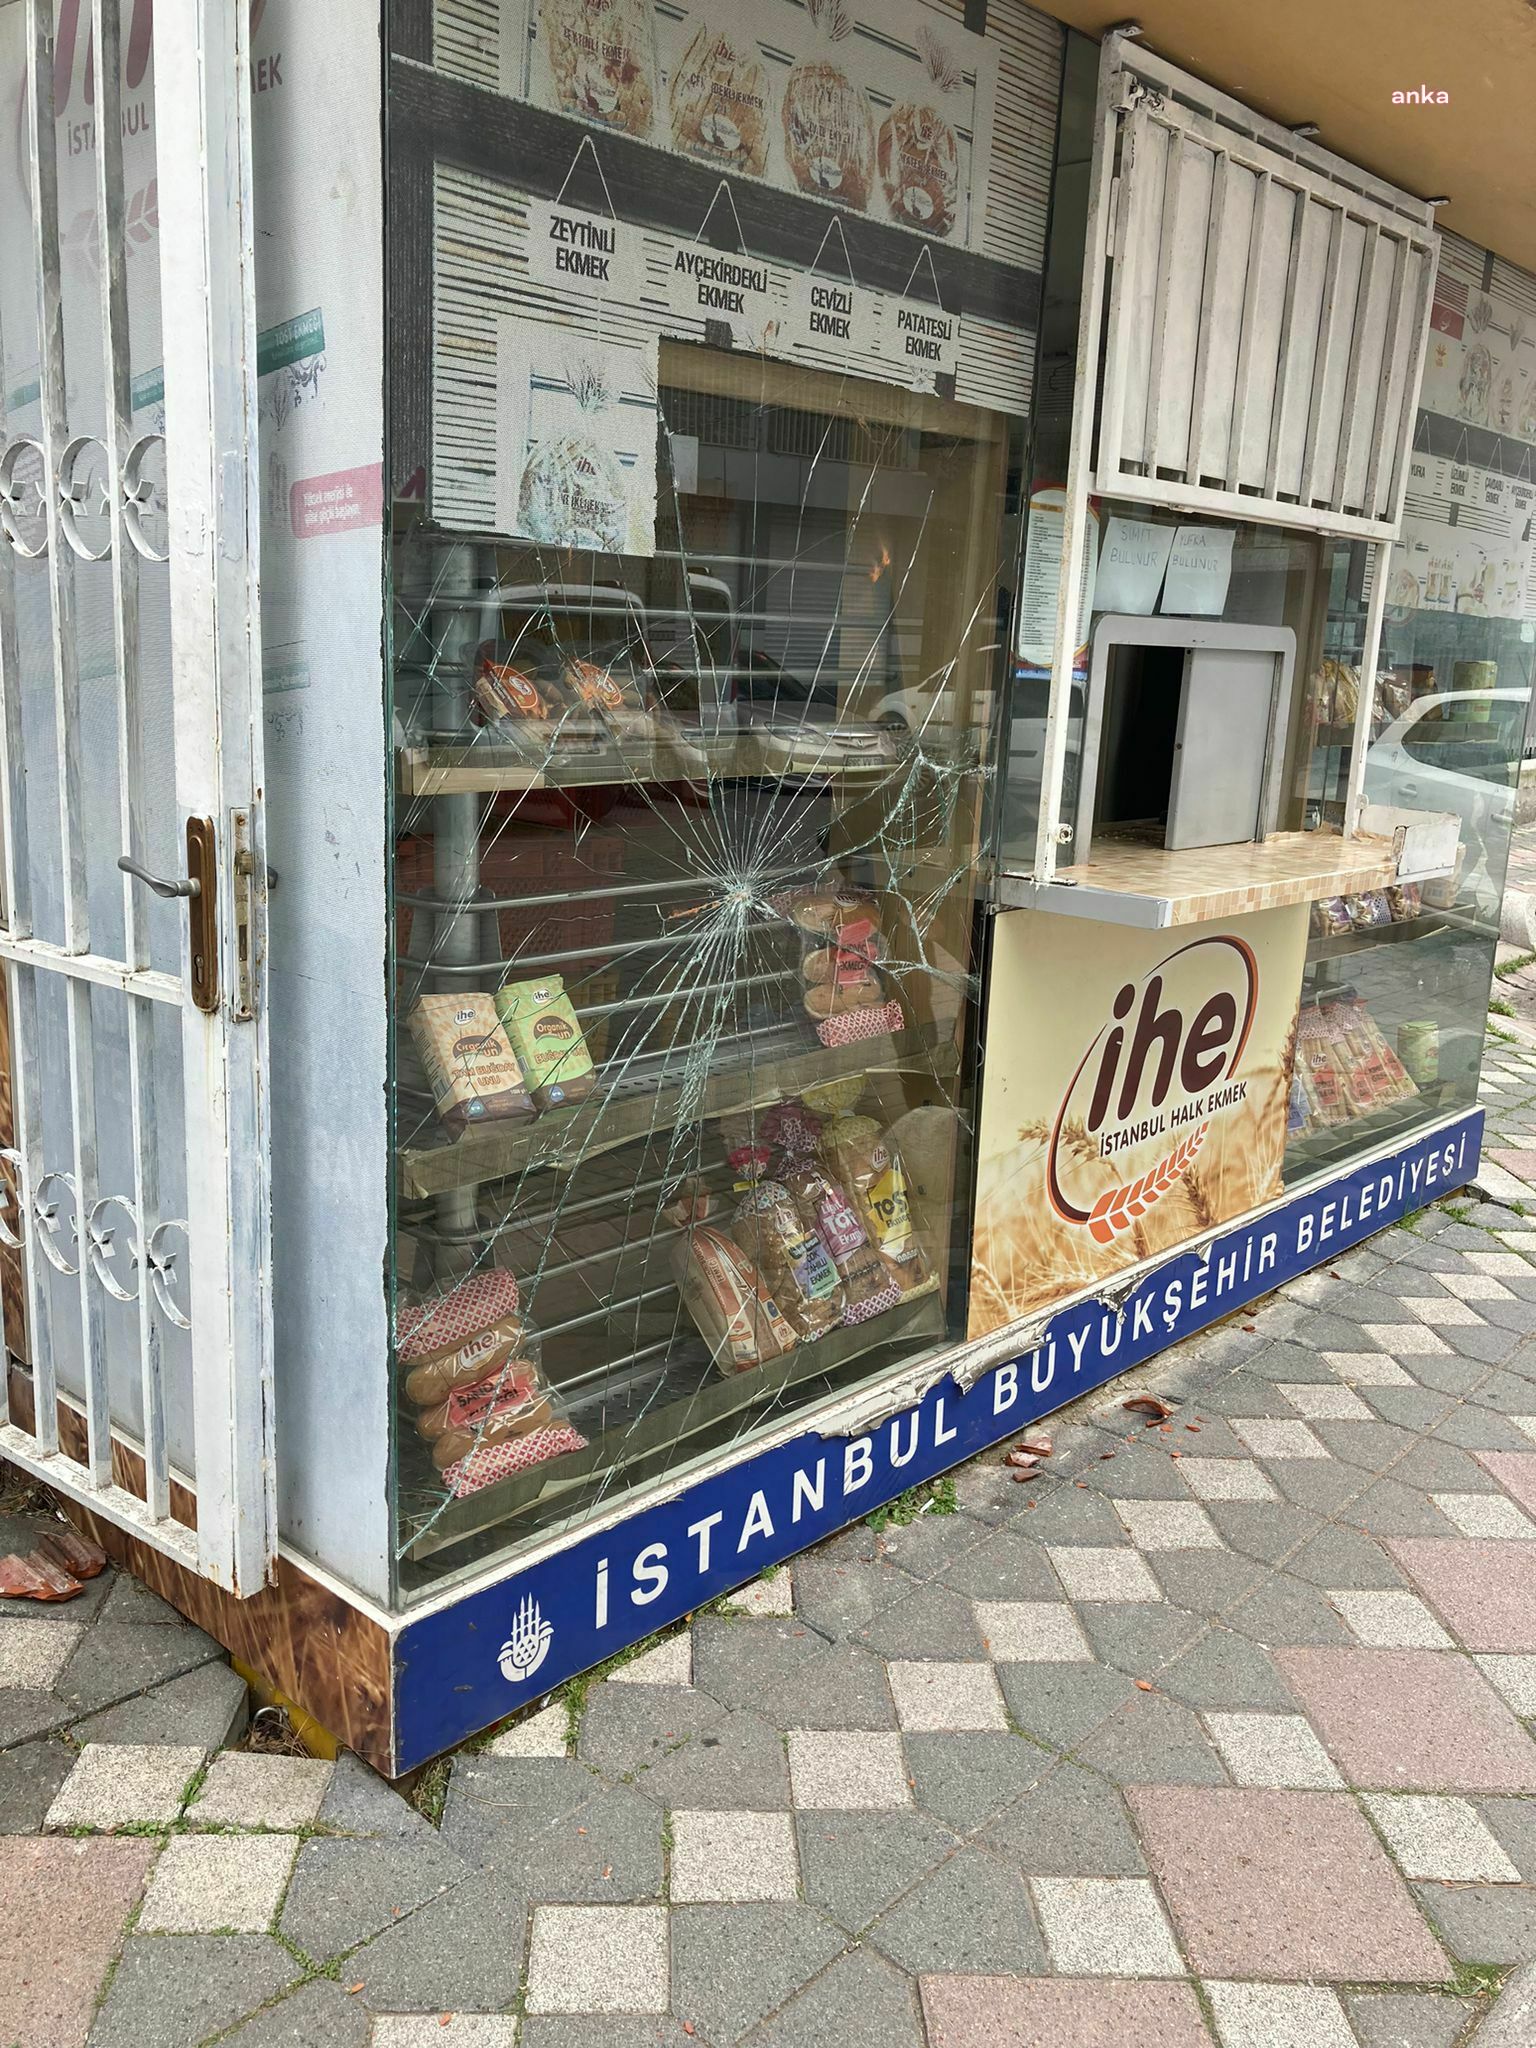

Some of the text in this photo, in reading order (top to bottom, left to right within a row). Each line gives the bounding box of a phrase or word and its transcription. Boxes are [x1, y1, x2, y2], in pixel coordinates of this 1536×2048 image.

[550, 215, 616, 254] ZEYTİNLİ
[556, 247, 610, 281] EKMEK
[674, 250, 768, 293] AYÇEKİRDEKLİ
[698, 284, 745, 314] EKMEK
[811, 286, 853, 315] CEVİZLİ
[809, 311, 851, 340] EKMEK
[897, 309, 952, 341] PATATESLİ
[905, 336, 942, 361] EKMEK
[534, 990, 551, 1000] ihe
[456, 1010, 475, 1021] ihe
[536, 1021, 569, 1034] Organik
[482, 1046, 499, 1057] un
[1088, 975, 1237, 1133] ihe
[476, 1075, 501, 1087] UNU
[1100, 1081, 1248, 1158] İSTANBUL HALK EKMEK
[1297, 1131, 1467, 1254] BELEDİYESİ
[463, 1331, 496, 1359] ihe
[595, 1397, 957, 1630] İSTANBUL
